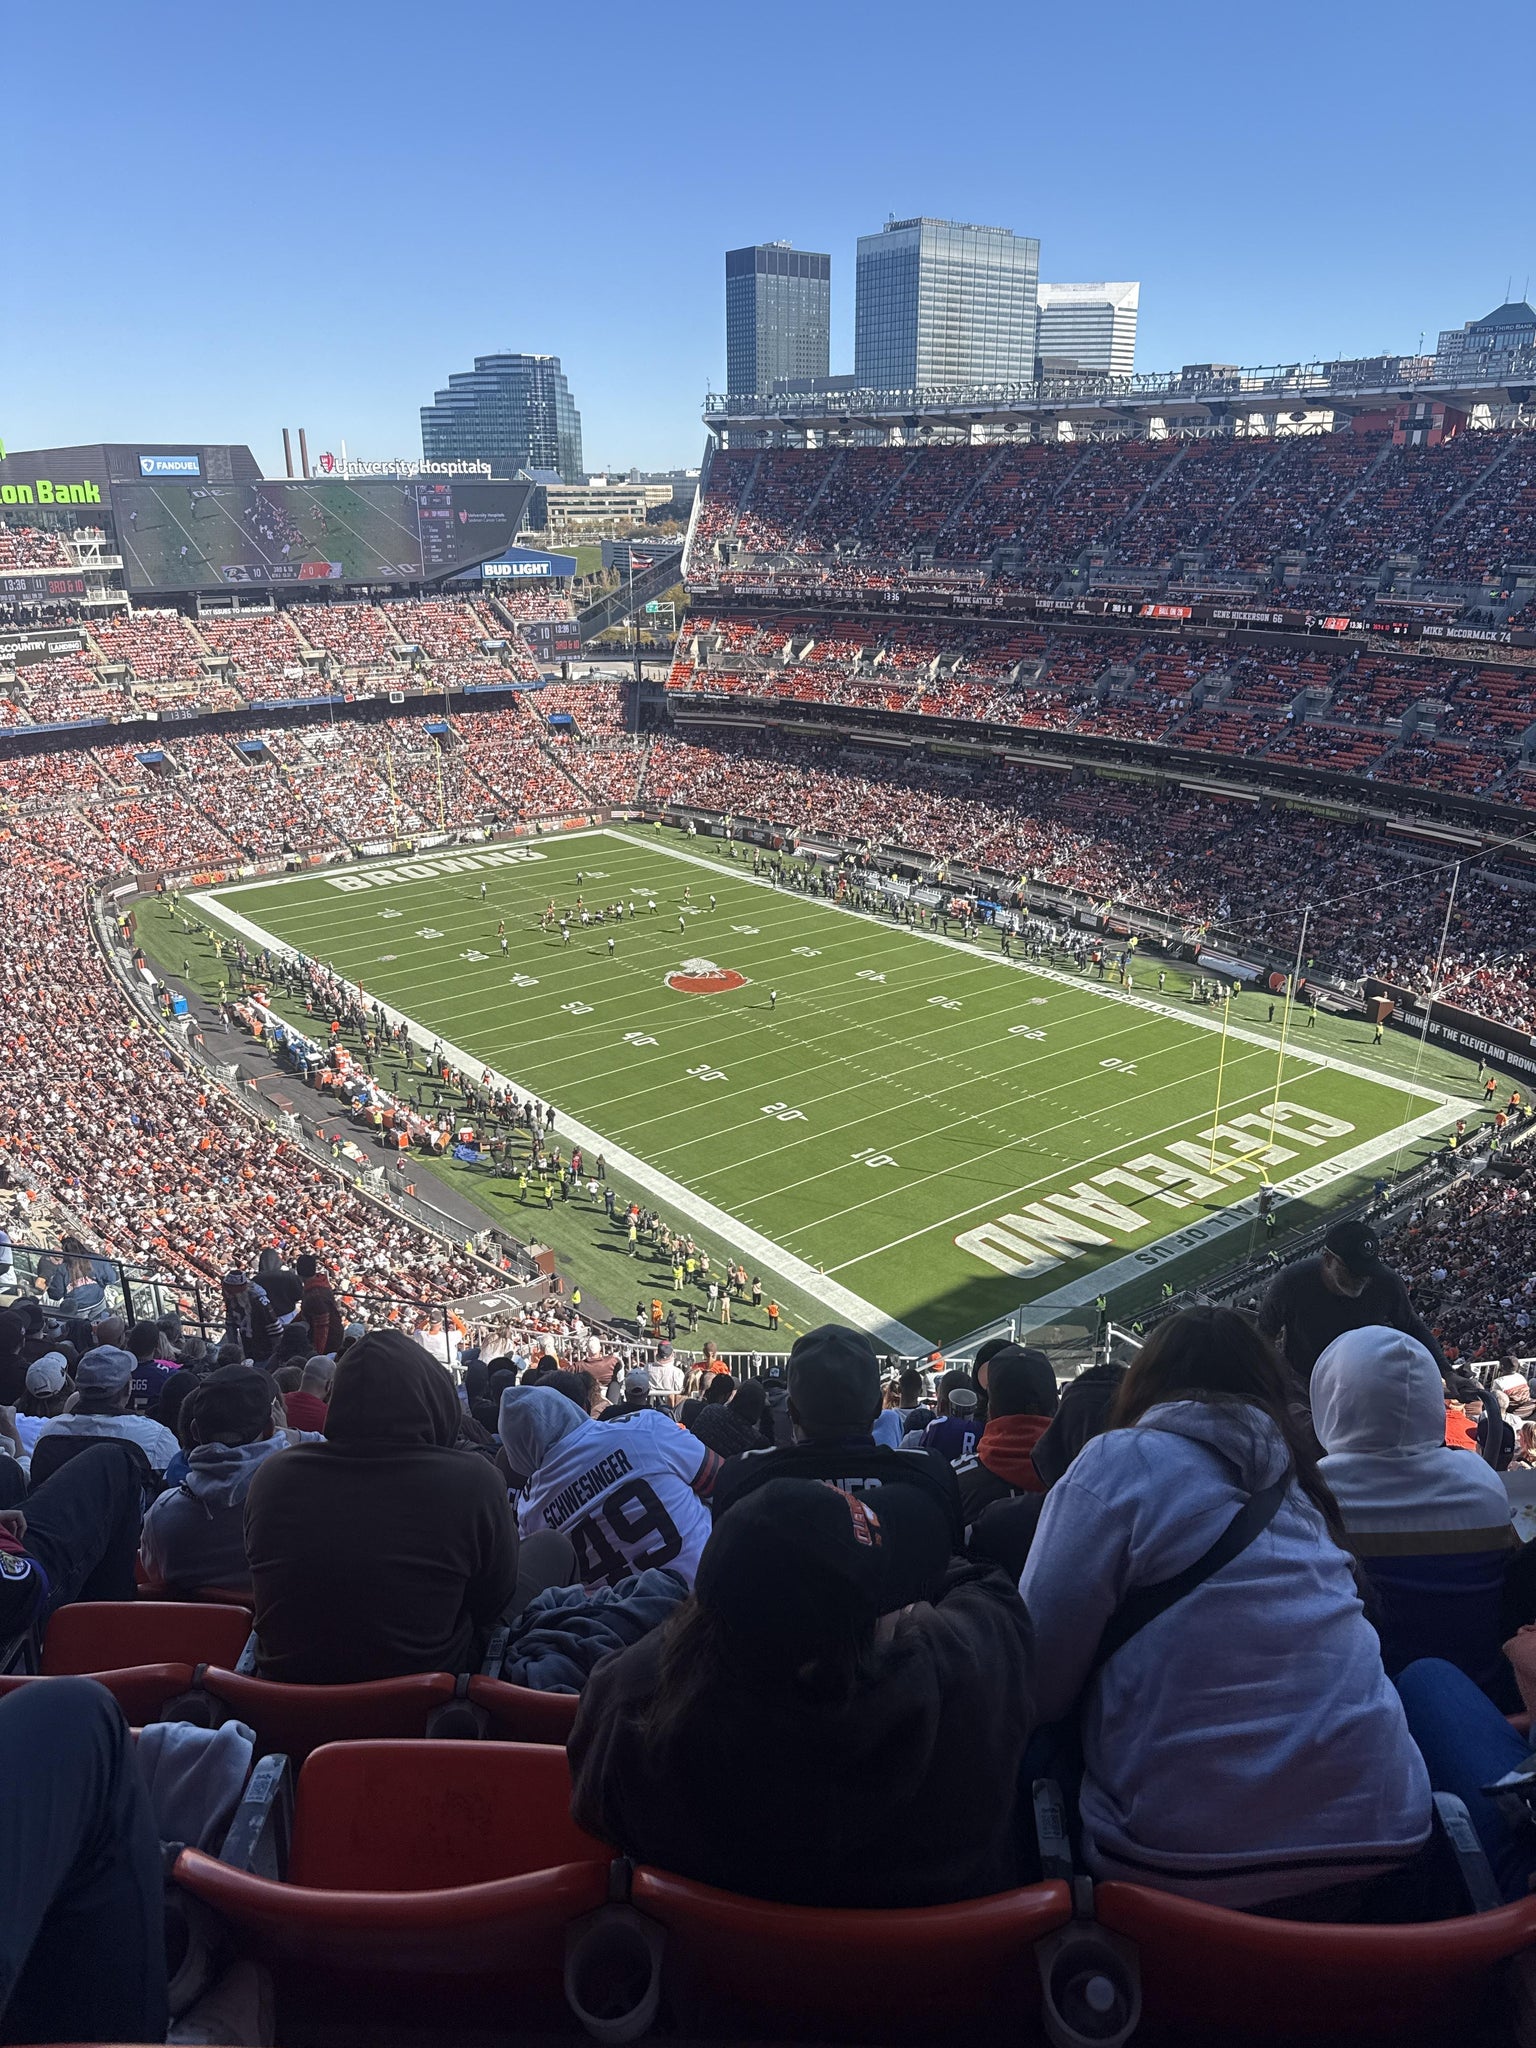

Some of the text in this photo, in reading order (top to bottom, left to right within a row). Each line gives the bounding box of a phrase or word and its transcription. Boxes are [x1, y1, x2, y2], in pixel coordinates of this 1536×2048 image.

[156, 461, 199, 470] FANDUEL
[336, 458, 487, 477] University Hospitals
[36, 480, 101, 504] Bank
[253, 568, 261, 577] 10
[484, 564, 549, 575] BUD LIGHT
[4, 579, 26, 591] 13:36
[35, 579, 42, 588] 11
[48, 580, 84, 593] 3RD & 10
[953, 596, 1004, 606] FRANK GATSKI 52
[1035, 600, 1086, 610] LEROY KELLY 44
[1159, 607, 1168, 615] BALL
[1213, 610, 1283, 623] GENE HICKERSON 66
[541, 627, 550, 639] 10
[555, 625, 569, 634] 13:36
[1423, 626, 1443, 636] MIKE
[1500, 632, 1511, 643] 74
[50, 643, 80, 651] LANDING
[543, 648, 549, 659] 0
[324, 848, 548, 892] BROWNS
[791, 946, 822, 957] 50
[509, 974, 539, 987] 40
[856, 969, 887, 983] 40
[560, 1001, 594, 1015] 50
[927, 995, 961, 1010] 30
[622, 1031, 654, 1046] 40
[1008, 1024, 1047, 1040] 20
[1404, 1013, 1428, 1031] HOME
[1429, 1023, 1441, 1034] OF
[1442, 1027, 1458, 1041] THE
[1460, 1034, 1505, 1060] CLEVELAND
[686, 1064, 723, 1081] 30
[1099, 1057, 1136, 1074] 10
[760, 1102, 803, 1121] 20
[850, 1147, 893, 1168] 10
[1327, 1162, 1349, 1176] IT
[954, 1101, 1356, 1279] CLEVELAND
[1206, 1205, 1253, 1228] ALL
[1176, 1227, 1209, 1248] OF
[1134, 1246, 1175, 1265] US
[542, 1448, 633, 1530] SCHWESINGER
[570, 1478, 682, 1588] 49
